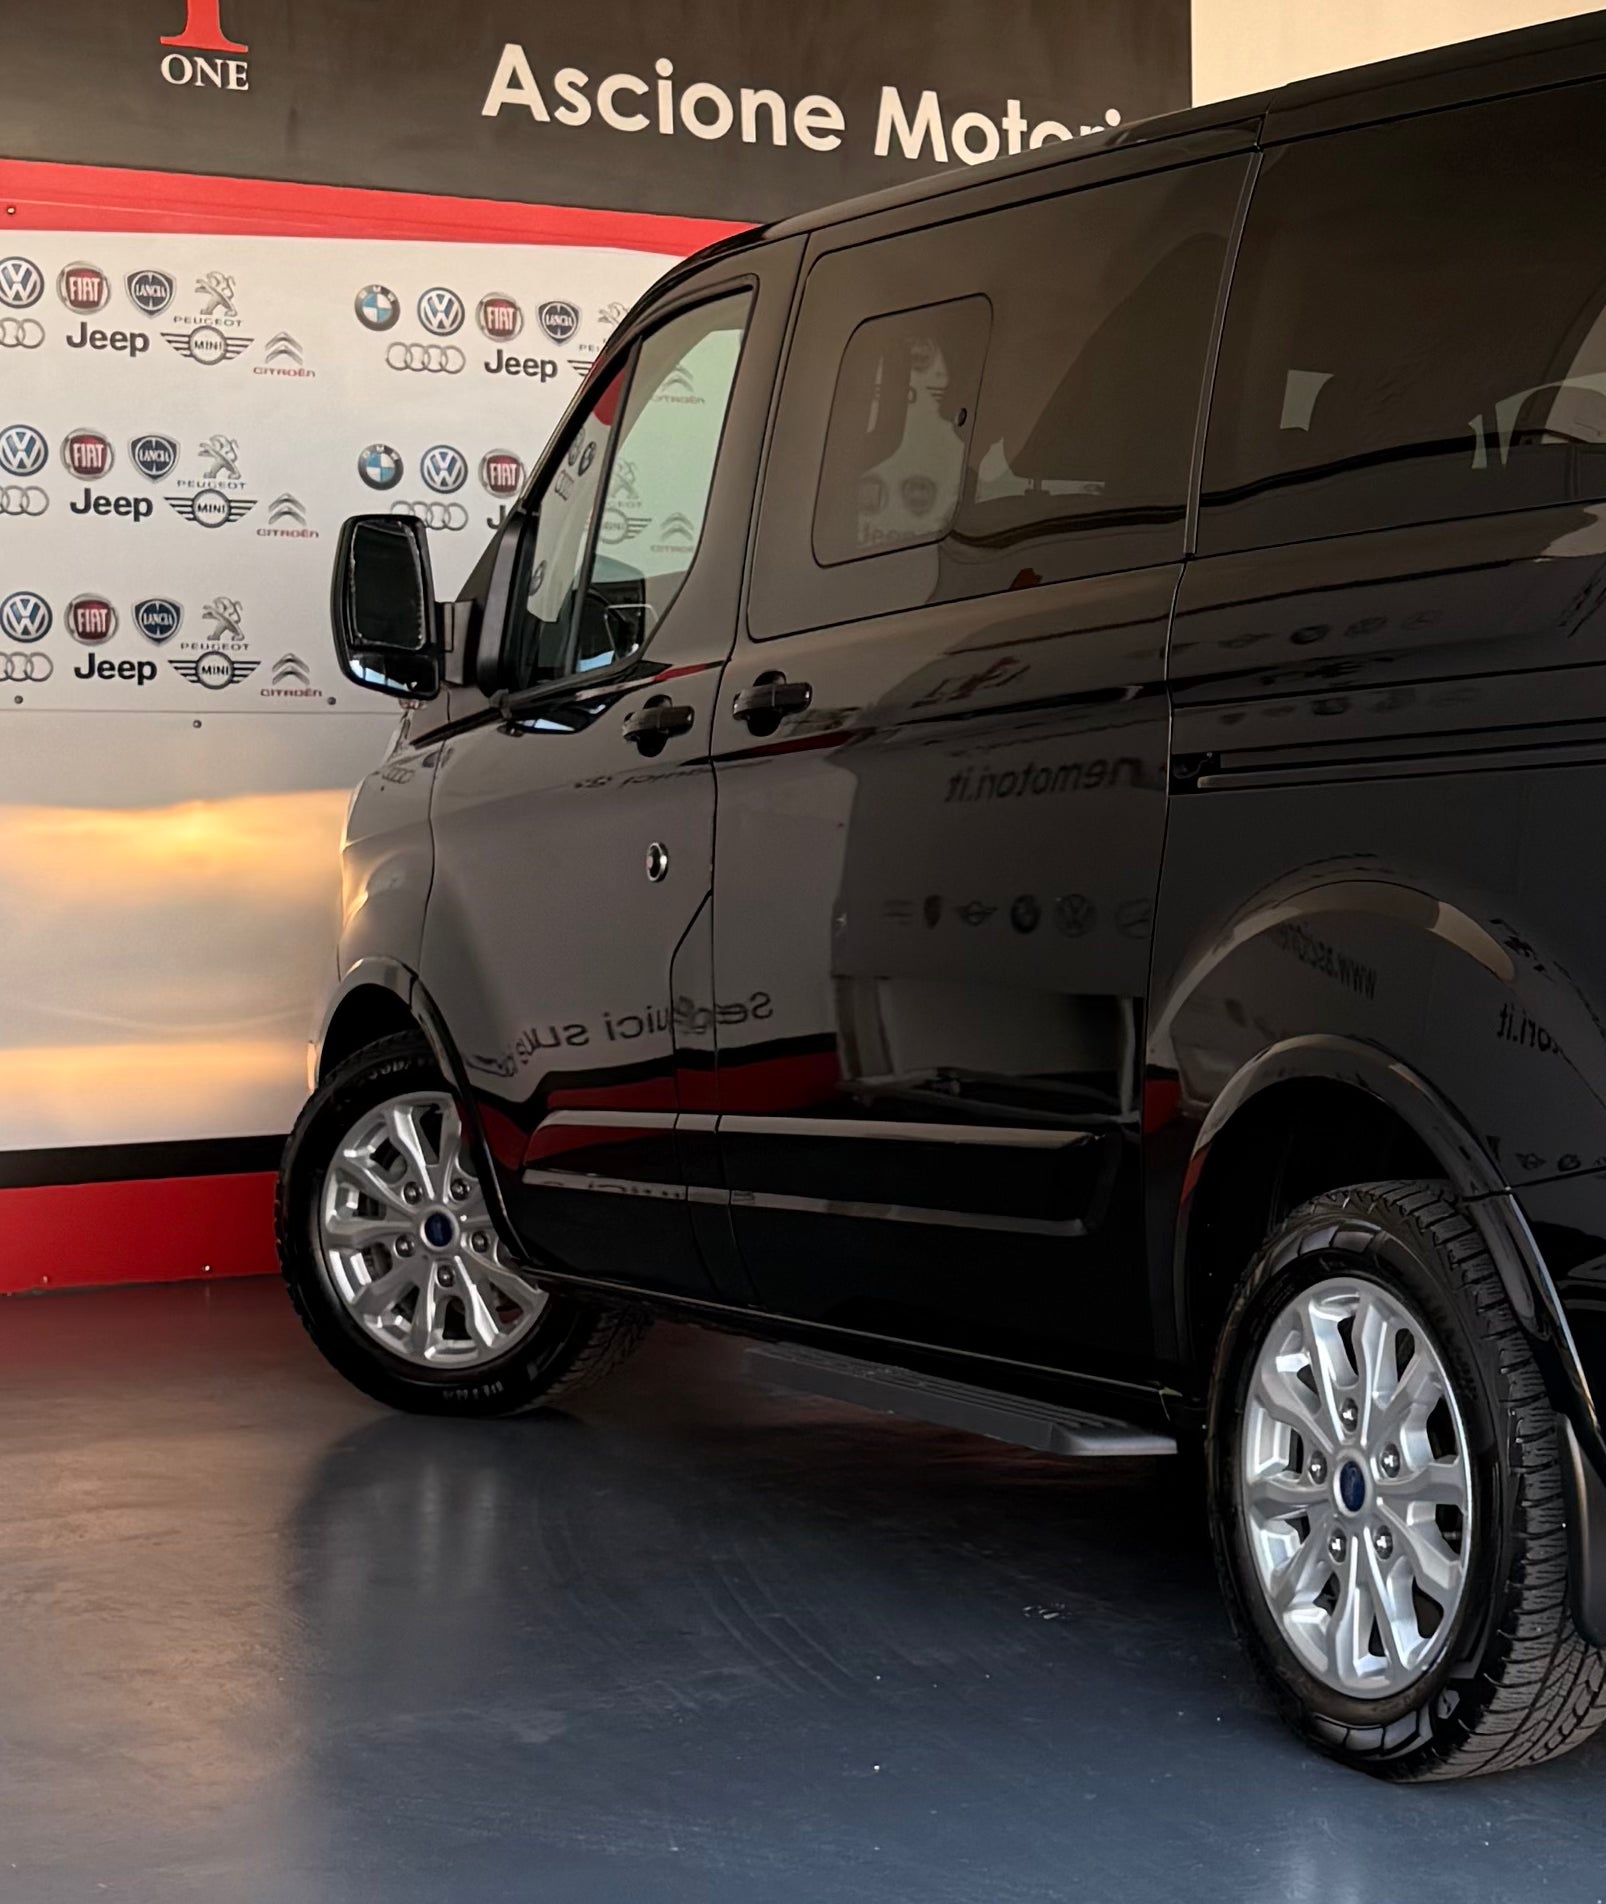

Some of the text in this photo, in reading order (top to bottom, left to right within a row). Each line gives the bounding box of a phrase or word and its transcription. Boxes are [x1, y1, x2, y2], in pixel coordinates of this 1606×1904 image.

[160, 52, 250, 91] ONE
[481, 43, 1122, 166] Ascione Mot
[69, 276, 101, 302] FIAT
[173, 315, 243, 327] PEUGEOT
[487, 306, 515, 329] FIAT
[66, 322, 150, 357] Jeep
[193, 338, 223, 352] MINI
[484, 349, 558, 382] Jeep
[73, 443, 105, 468] FIAT
[176, 479, 247, 490] PEUGEOT
[489, 462, 517, 486] FIAT
[70, 488, 154, 522] Jeep
[196, 503, 226, 515] MINI
[77, 608, 108, 633] FIAT
[180, 642, 250, 652] PEUGEOT
[74, 653, 158, 685] Jeep
[201, 663, 230, 676] MINI
